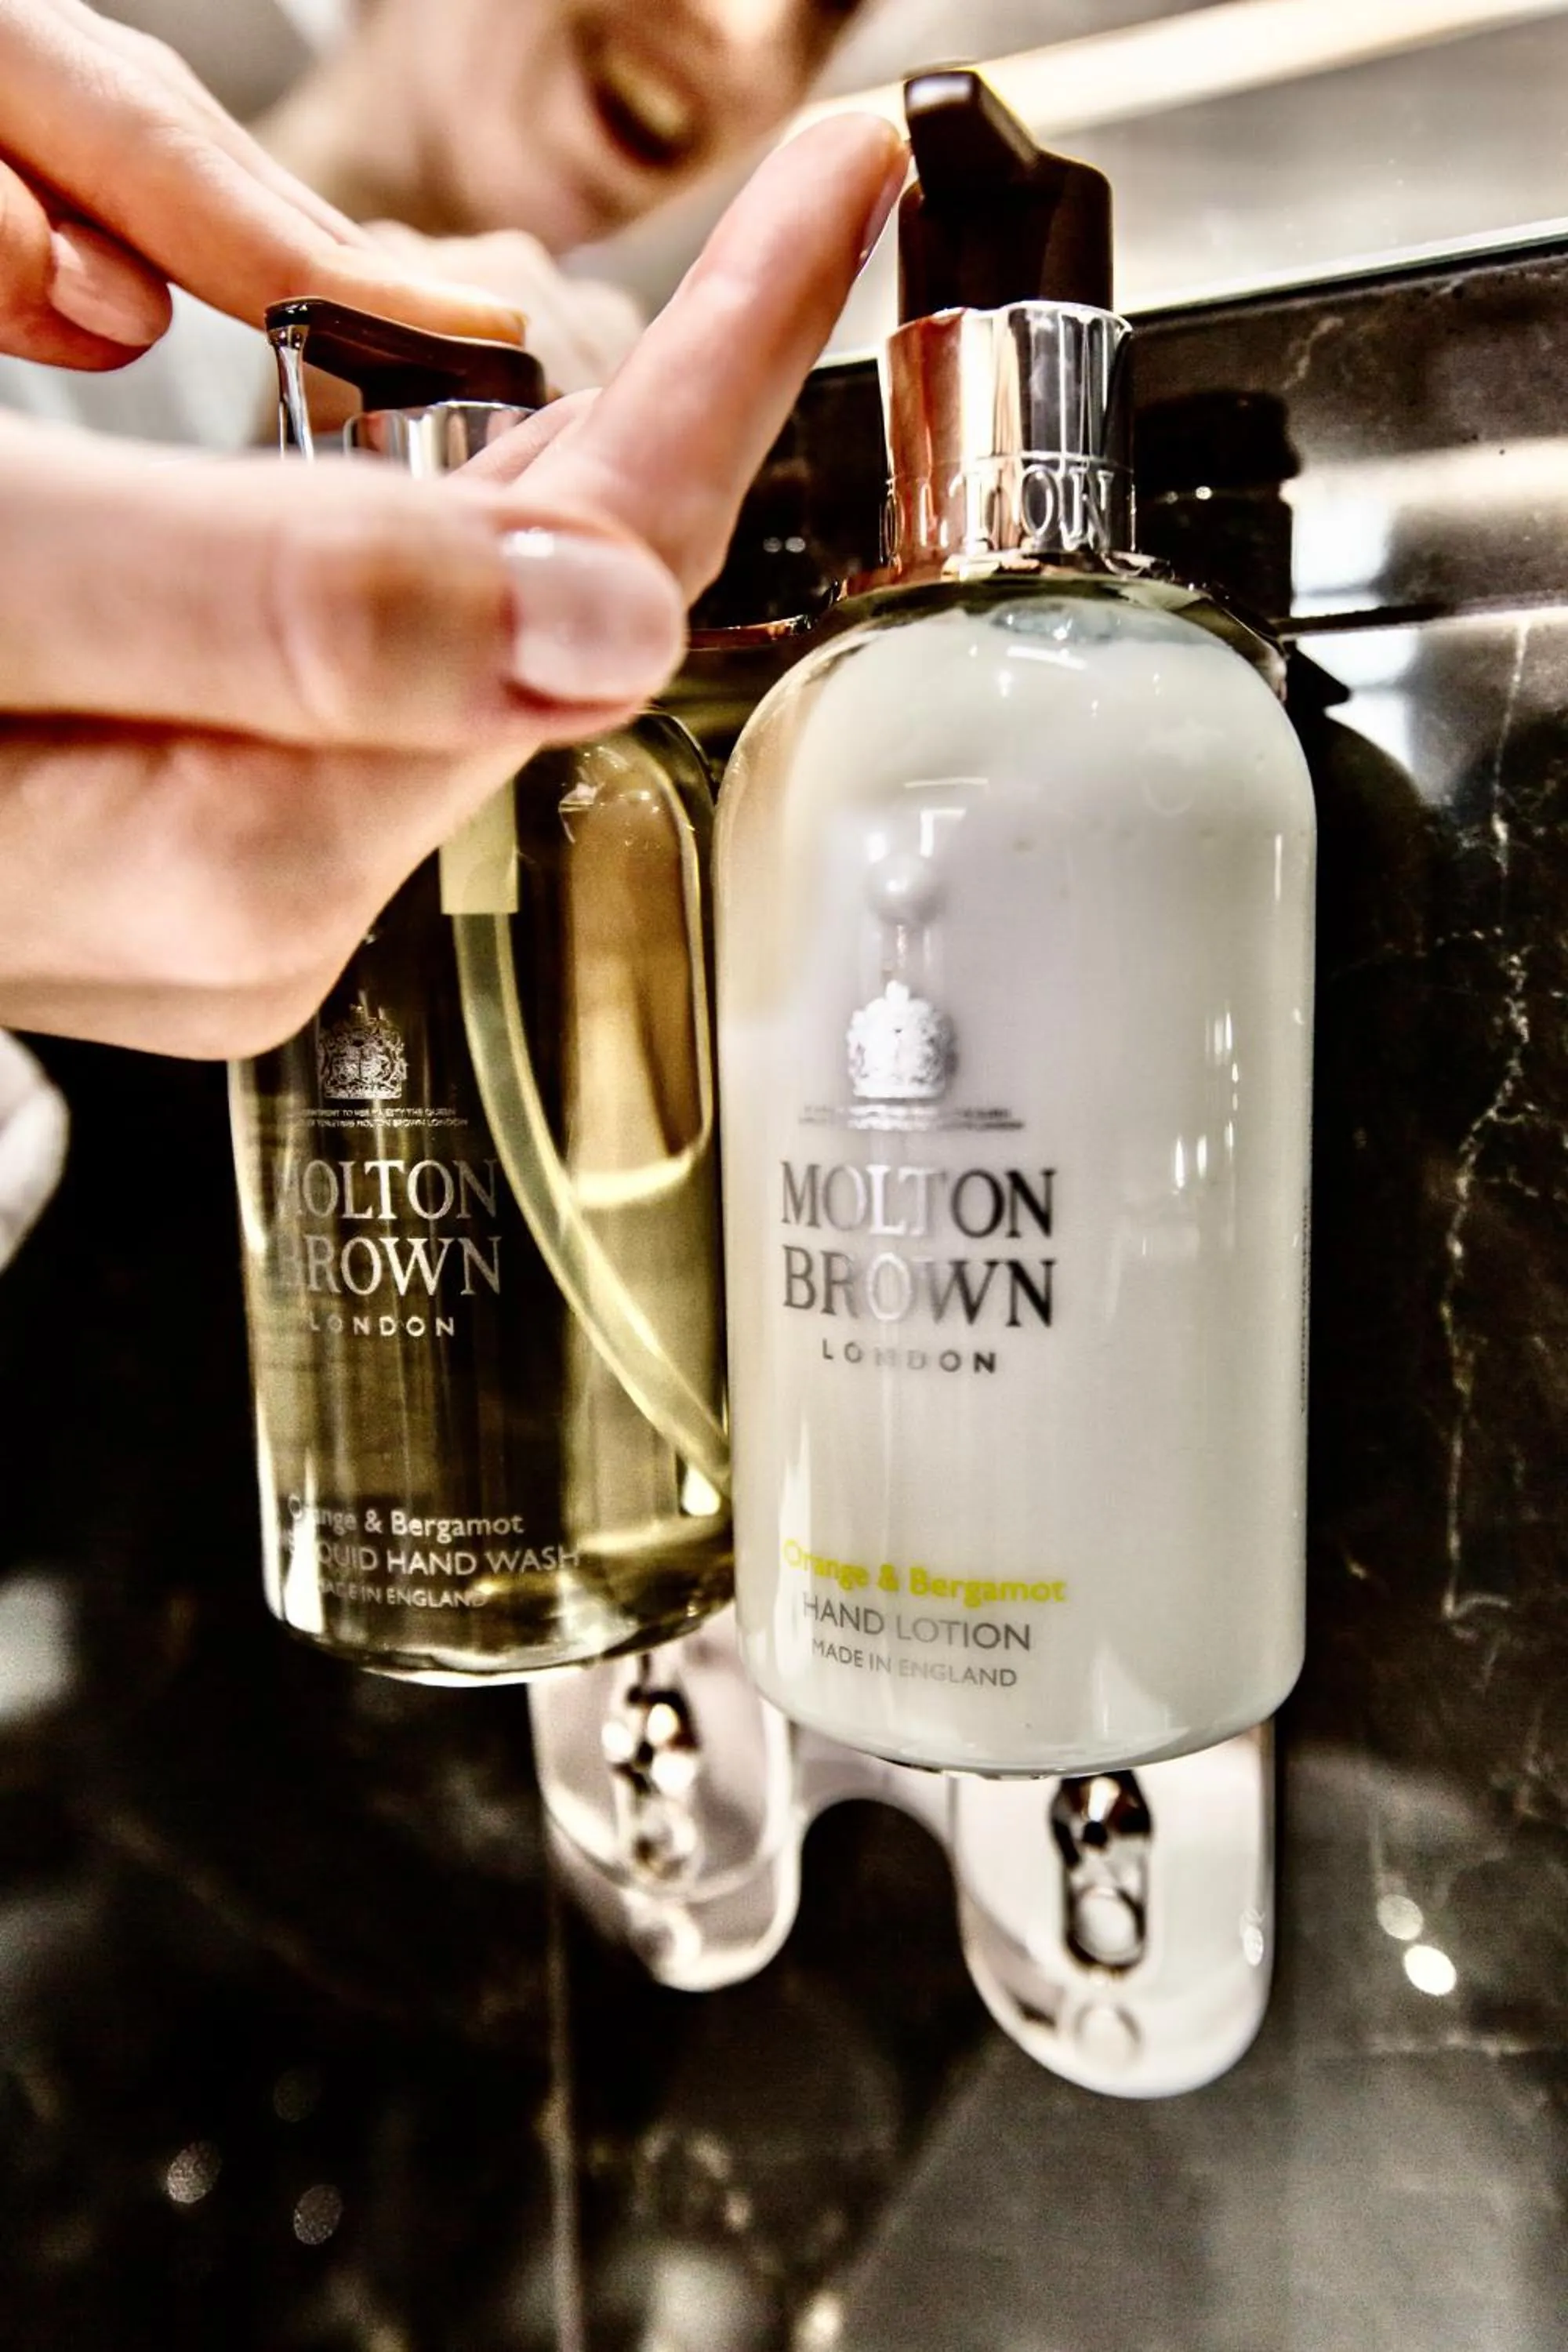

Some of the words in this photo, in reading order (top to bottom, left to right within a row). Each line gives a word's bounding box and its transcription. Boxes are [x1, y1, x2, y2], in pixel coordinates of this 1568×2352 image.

[278, 1159, 498, 1220] OLTON
[780, 1160, 1057, 1239] MOLTON
[781, 1245, 1057, 1329] BROWN
[310, 1311, 456, 1337] LONDON
[822, 1338, 996, 1374] LONDON
[288, 1493, 358, 1537] Onge
[364, 1508, 383, 1534] &
[390, 1509, 526, 1544] Bergamot
[387, 1548, 477, 1577] HAND
[484, 1544, 581, 1574] WASH
[782, 1538, 870, 1592] Orange
[876, 1563, 901, 1592] &
[909, 1565, 1068, 1609] Bergamot
[361, 1584, 383, 1605] IN
[386, 1586, 491, 1610] ENGLAND
[802, 1592, 885, 1636] HAND
[895, 1614, 1032, 1652] LOTION
[811, 1637, 864, 1668] MADE
[869, 1653, 892, 1675] IN
[898, 1658, 1018, 1687] ENGLAND
